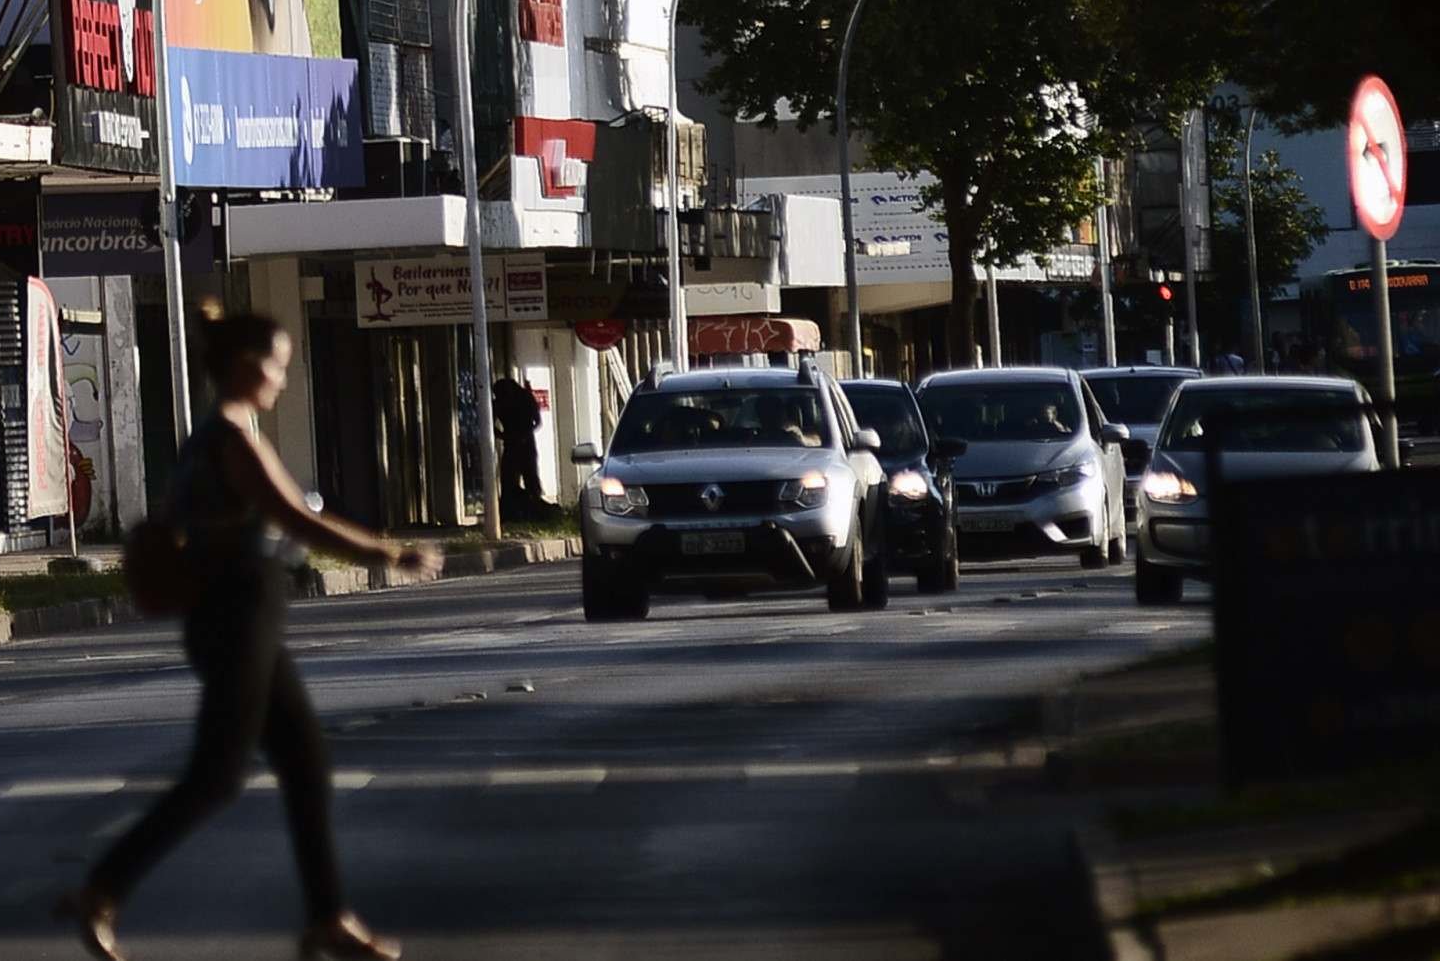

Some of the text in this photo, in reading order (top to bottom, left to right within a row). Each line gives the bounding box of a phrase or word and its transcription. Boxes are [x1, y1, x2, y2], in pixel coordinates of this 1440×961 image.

[42, 227, 148, 253] ancorbrás
[397, 282, 423, 297] Por
[425, 284, 452, 300] que
